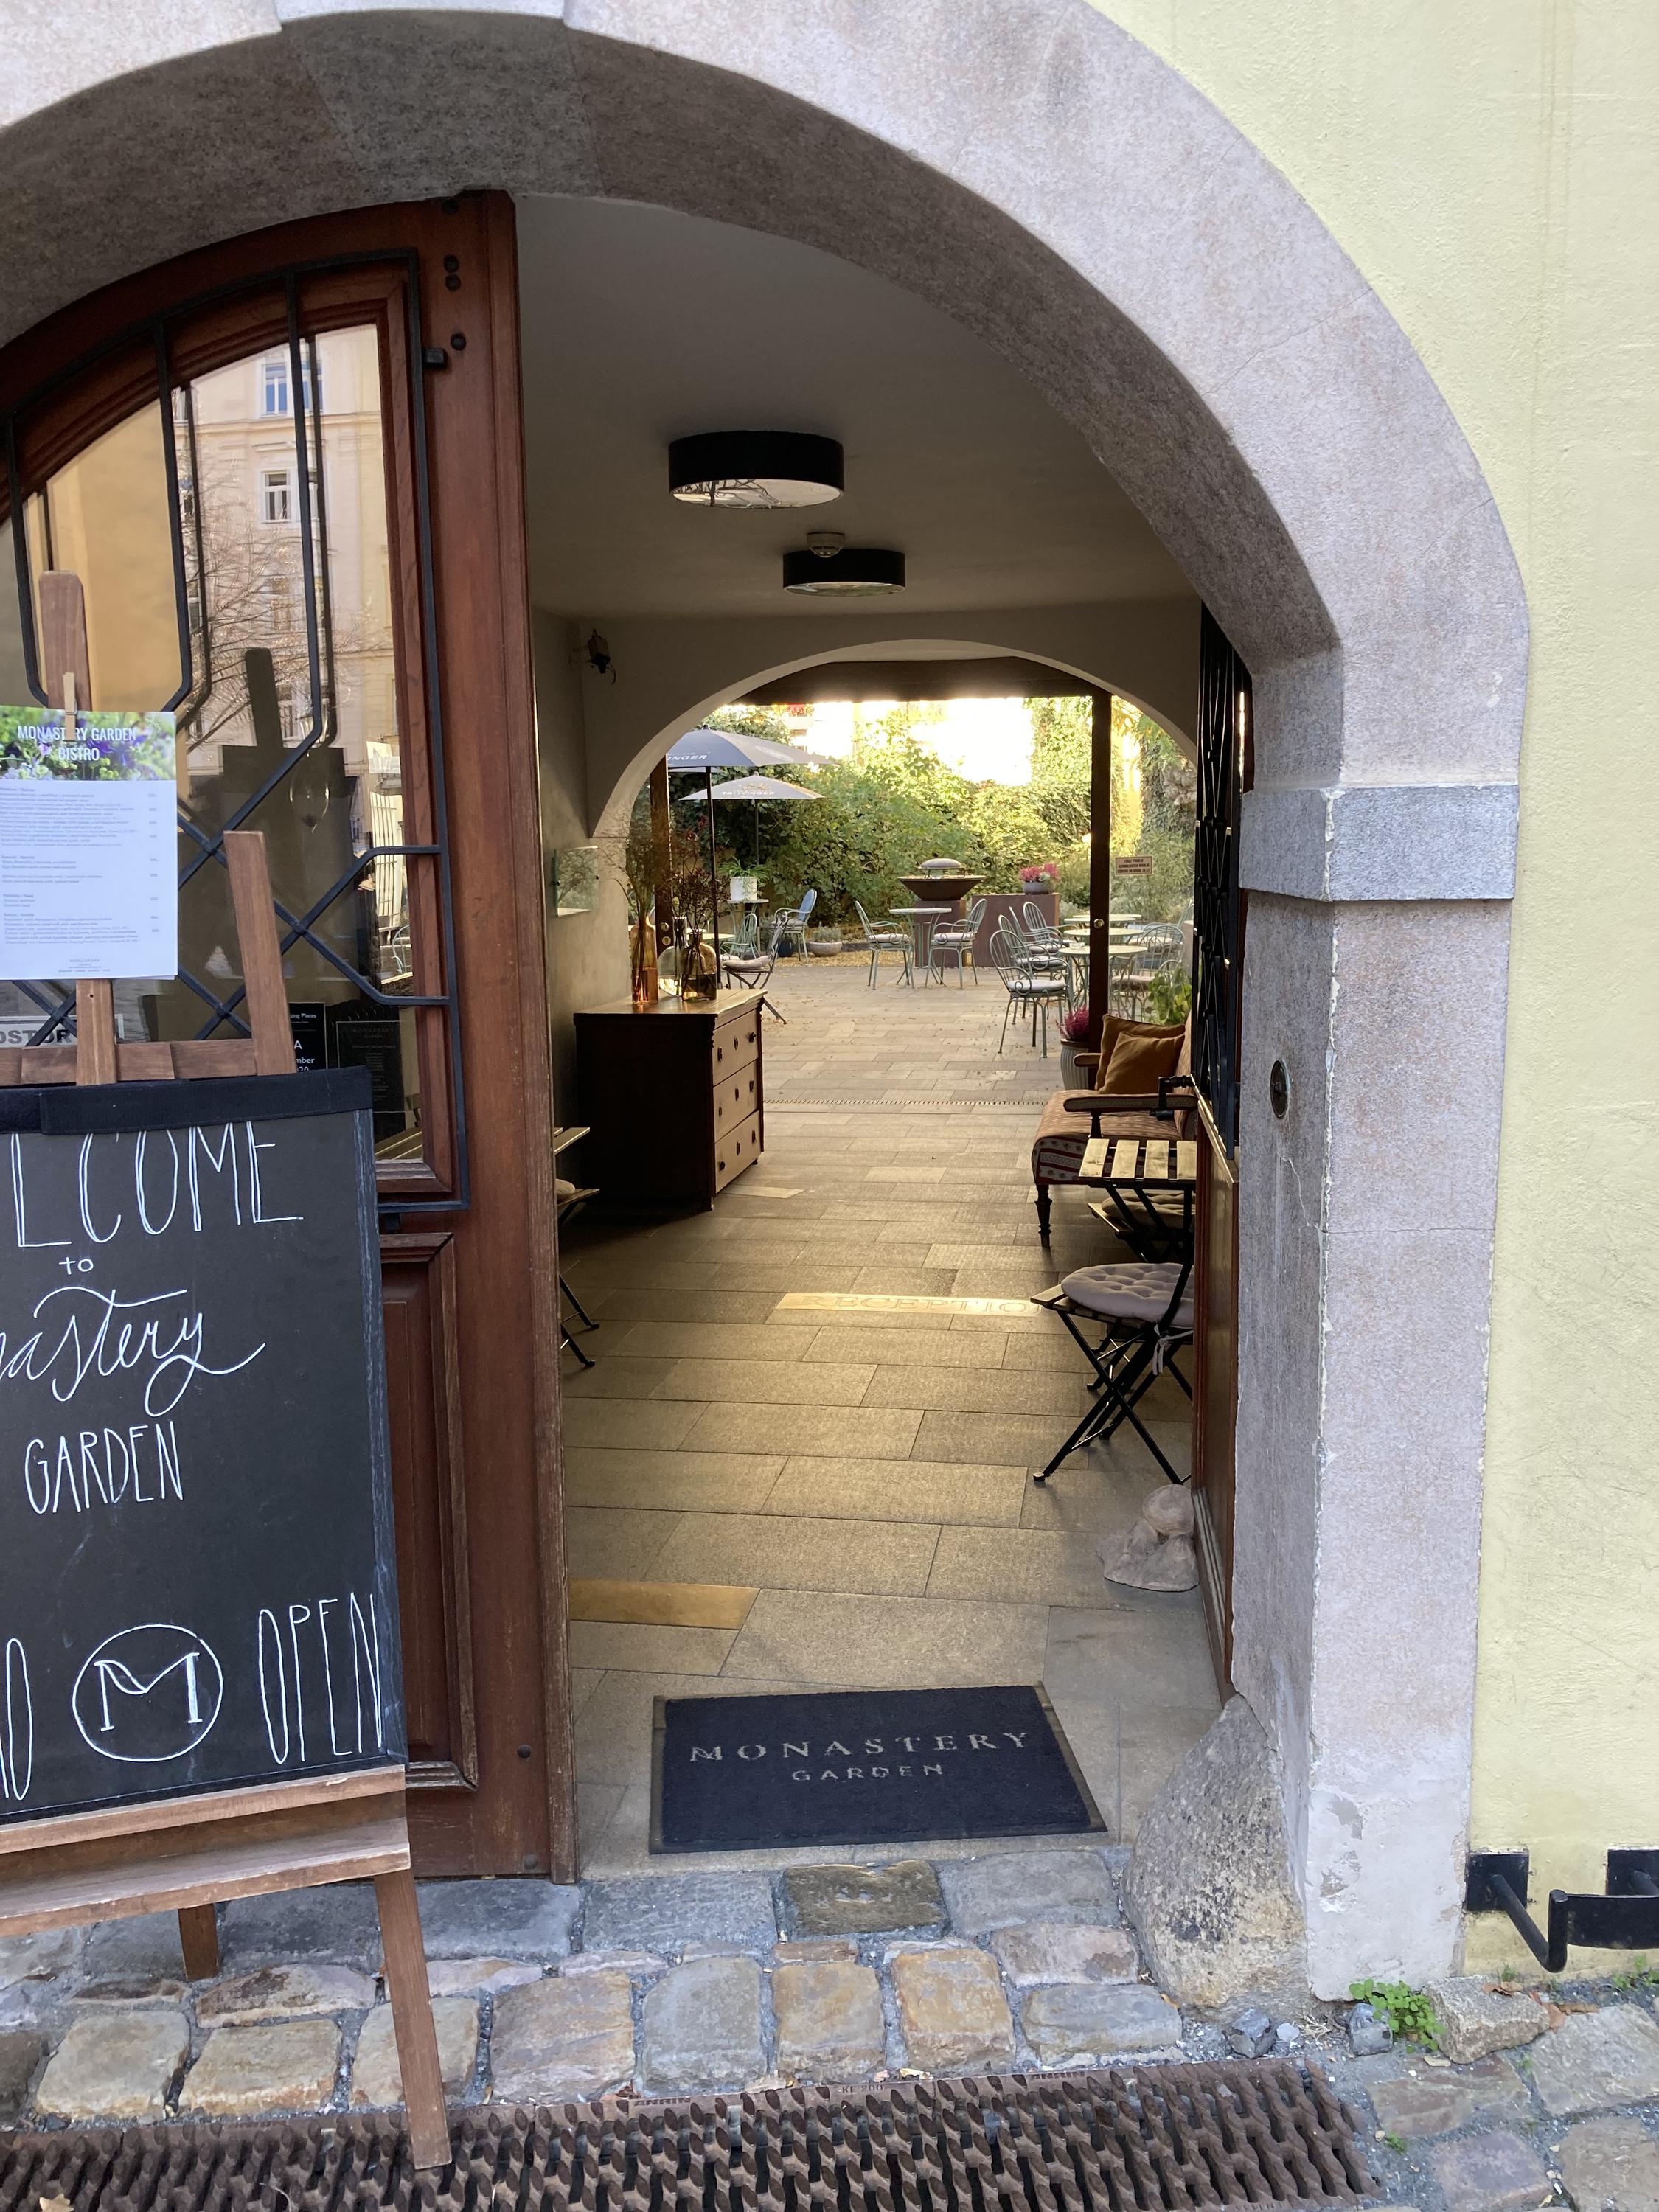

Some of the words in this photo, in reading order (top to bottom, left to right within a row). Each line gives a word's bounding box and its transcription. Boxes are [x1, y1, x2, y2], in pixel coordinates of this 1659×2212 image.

[18, 725, 88, 741] MONASTRY
[91, 728, 137, 742] GARDEN
[58, 747, 100, 762] BISTRO
[58, 1256, 94, 1276] to
[24, 1420, 184, 1514] GARDEN
[258, 1592, 383, 1764] OPEN
[690, 1731, 1028, 1762] MONASTERY
[792, 1764, 944, 1782] GARDEN
